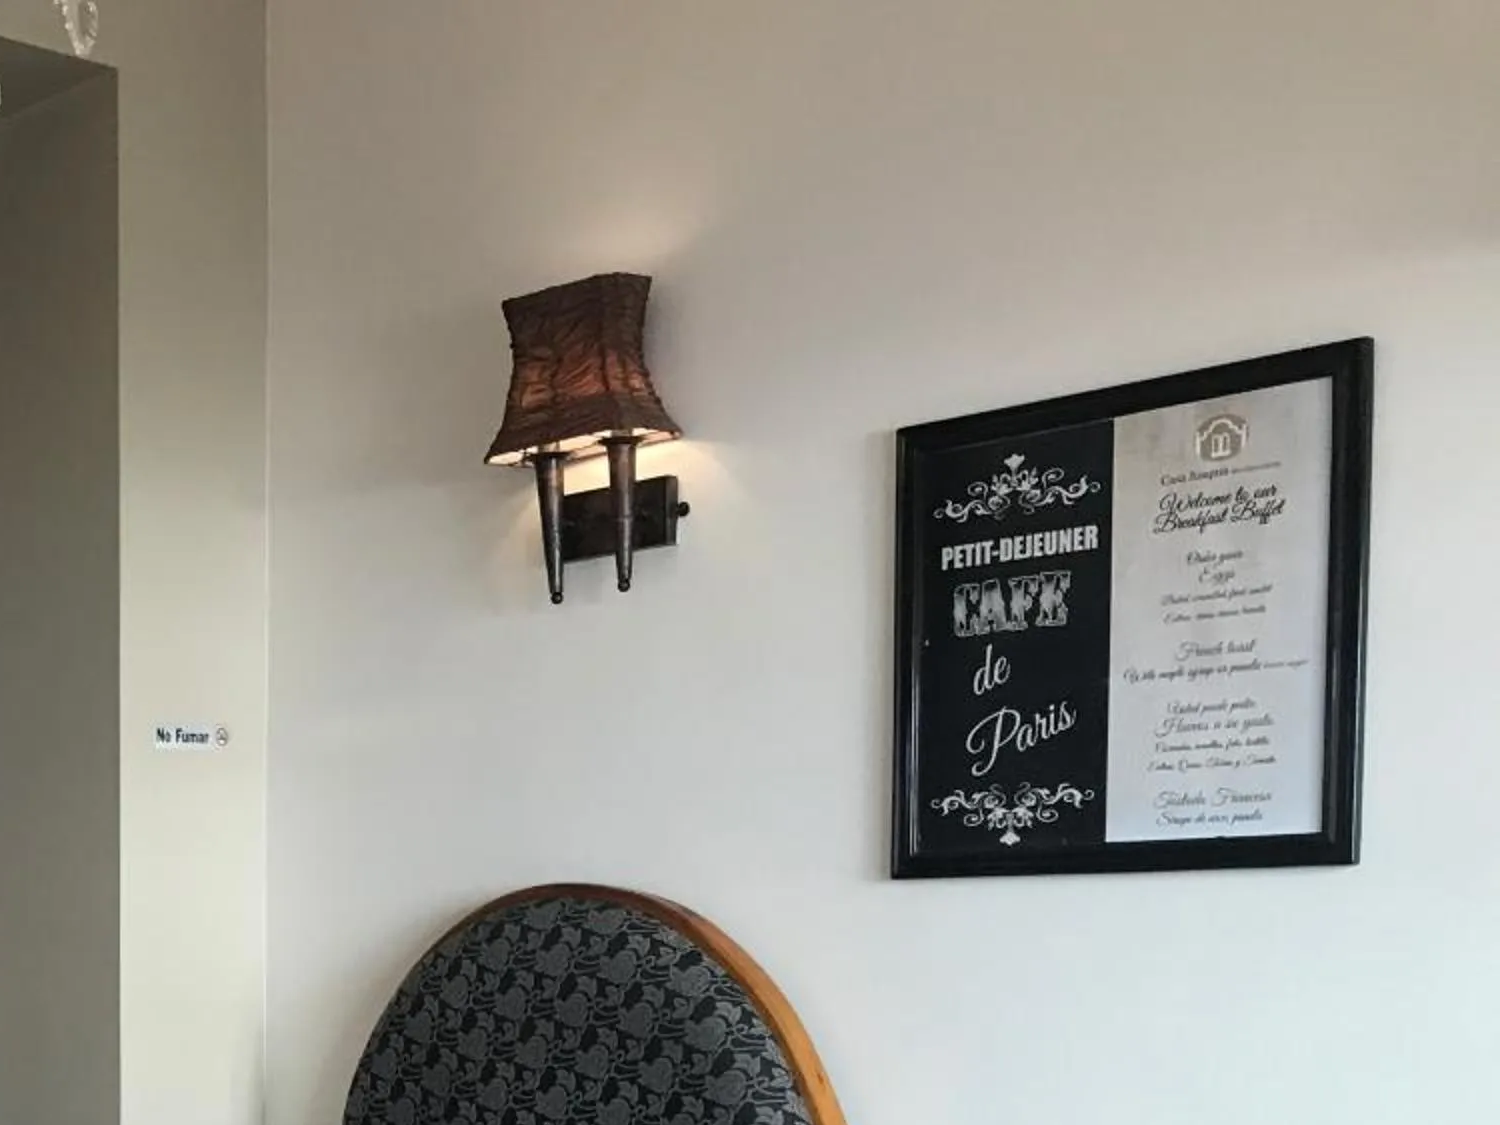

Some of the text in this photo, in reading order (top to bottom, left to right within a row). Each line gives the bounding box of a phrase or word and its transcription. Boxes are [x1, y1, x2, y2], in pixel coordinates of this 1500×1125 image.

[1153, 499, 1286, 535] Breakfast Buffet
[1159, 491, 1232, 512] Welcome
[941, 525, 1099, 571] PETIT-DEJEUNER
[973, 643, 1011, 695] de
[156, 727, 209, 744] No Fumar
[966, 701, 1077, 777] Paris
